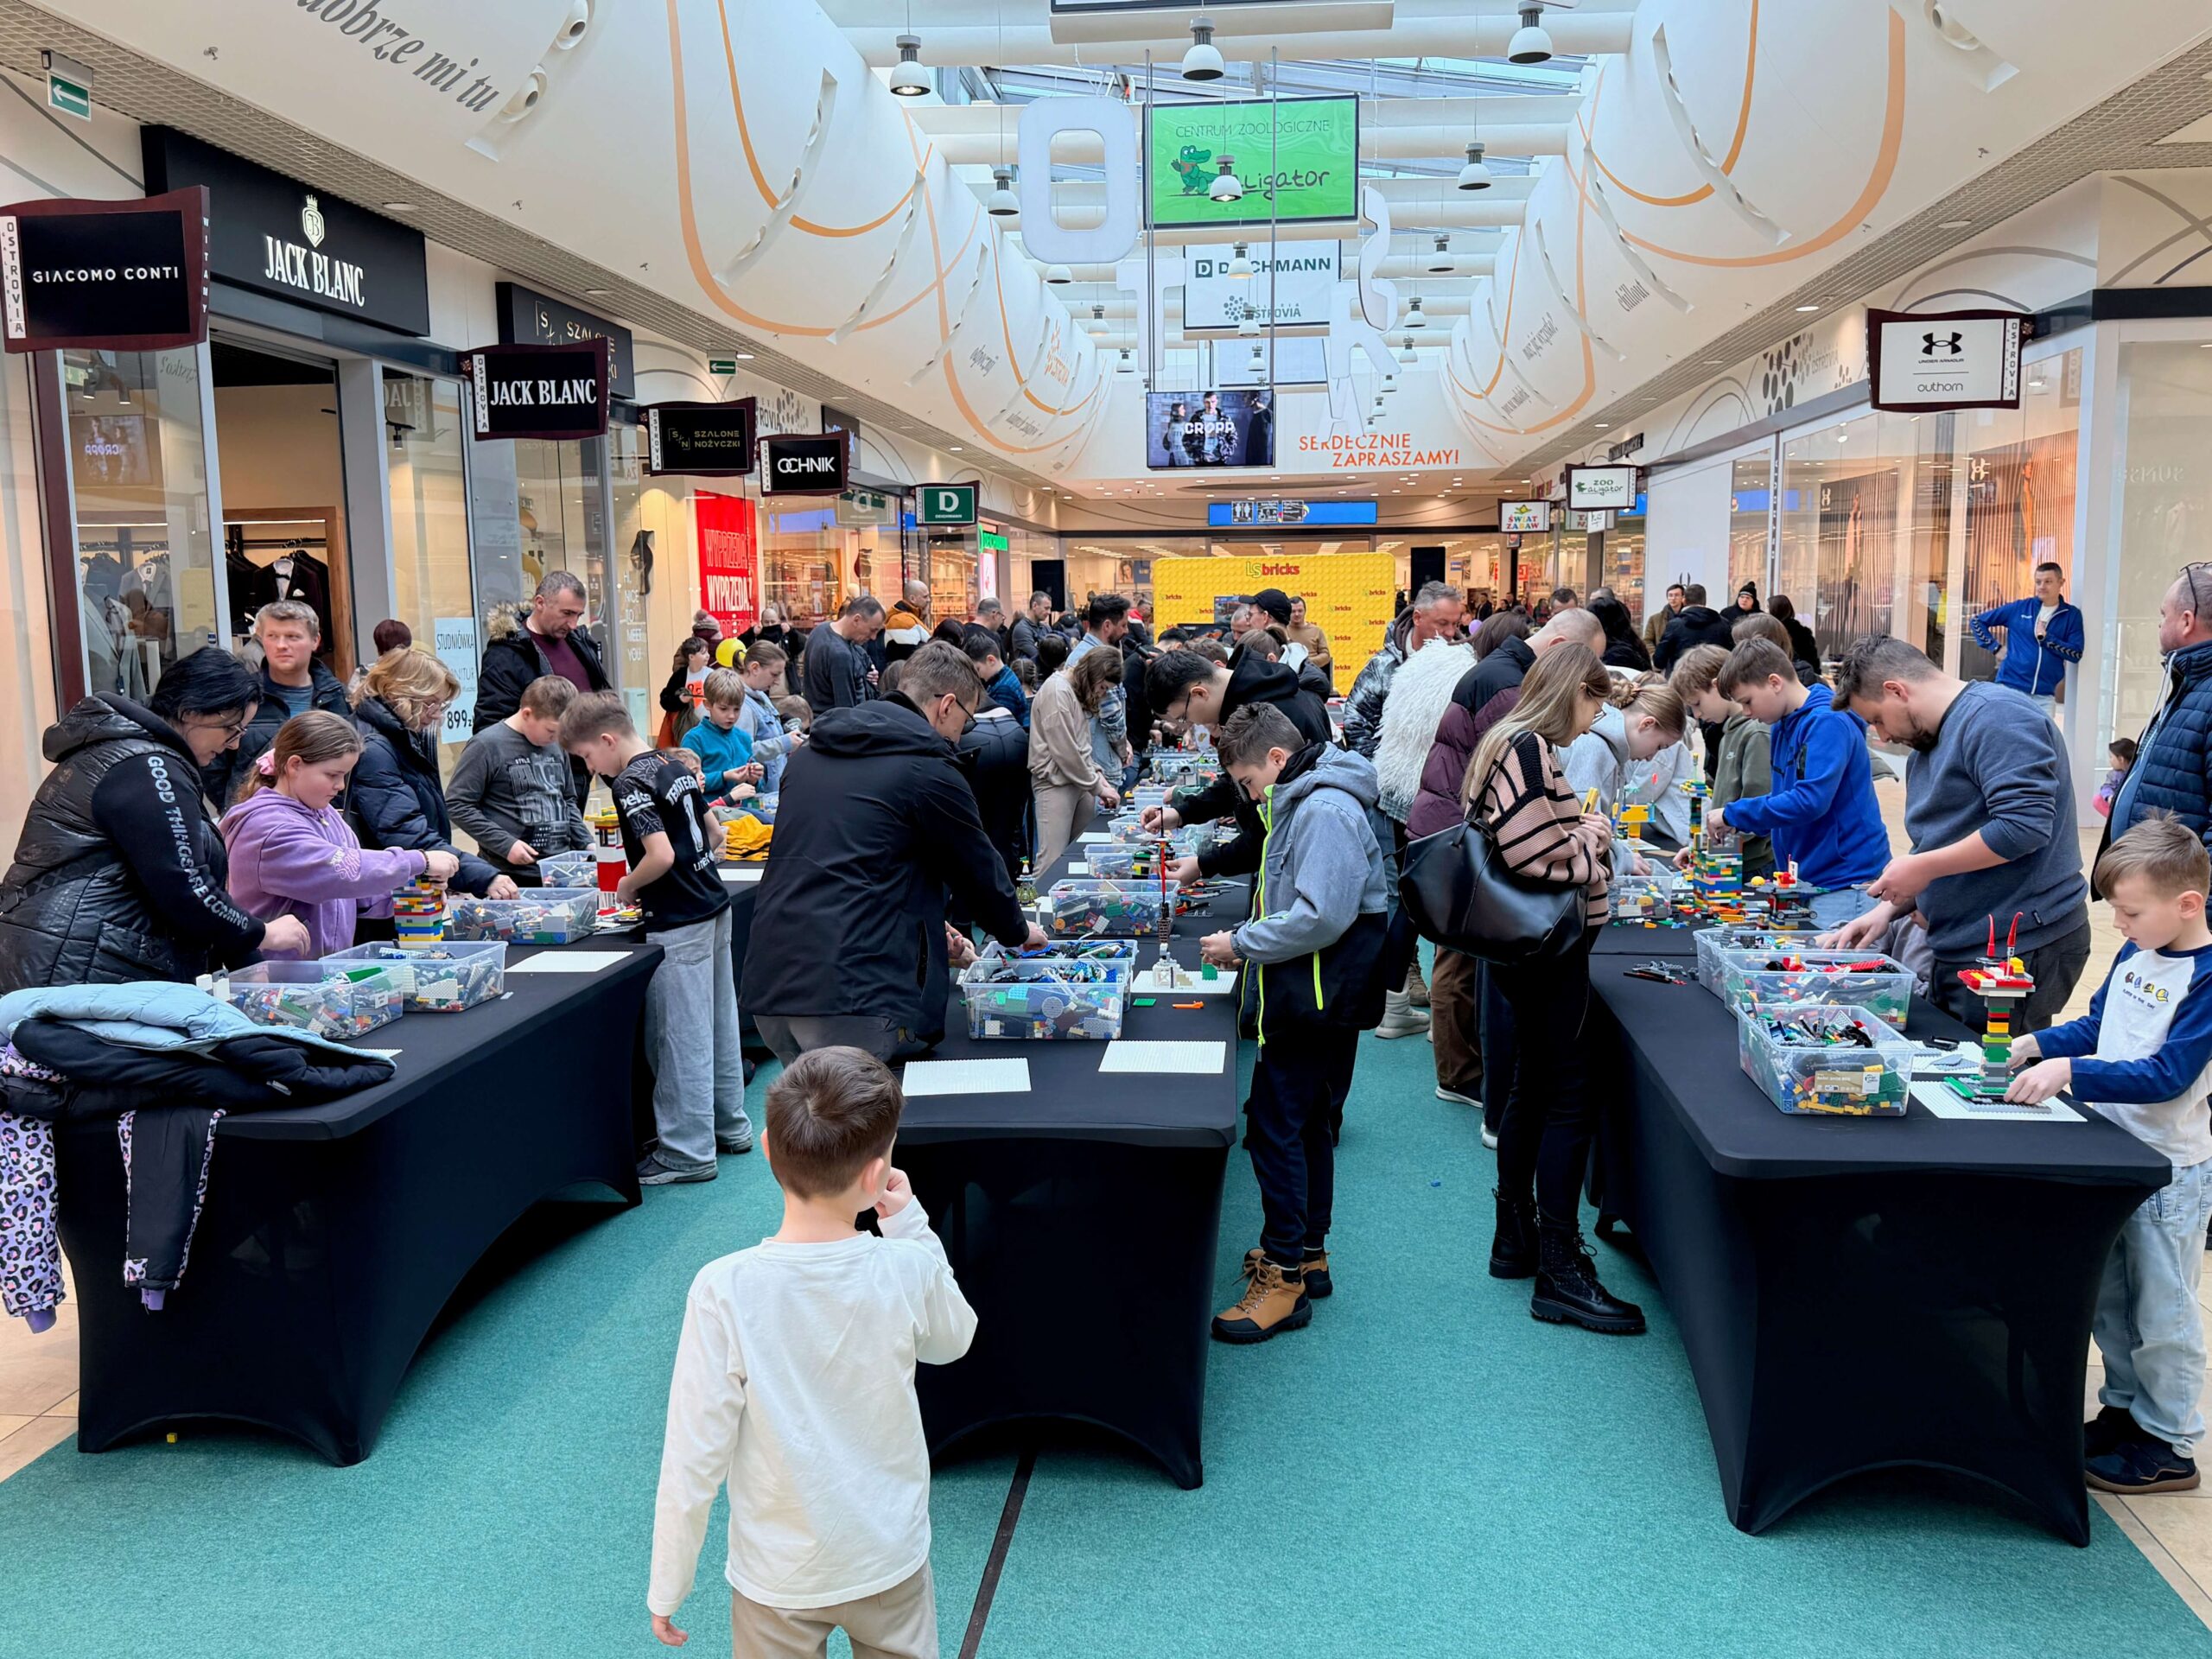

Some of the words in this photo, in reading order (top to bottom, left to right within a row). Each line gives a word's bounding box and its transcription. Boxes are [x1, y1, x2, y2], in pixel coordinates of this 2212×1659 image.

[412, 53, 479, 92] mi
[456, 75, 499, 112] tu
[1175, 124, 1232, 138] CENTRUM
[1238, 119, 1331, 136] ZOOLOGICZNE
[33, 269, 117, 283] GIACOMO
[124, 266, 179, 280] CONTI
[265, 235, 310, 290] JACK
[311, 251, 365, 308] BLANC
[1219, 257, 1331, 275] DCHMANN
[7, 221, 23, 334] OSTROVIA
[1615, 278, 1649, 312] chillout
[1255, 307, 1301, 319] STROVIA
[2009, 322, 2018, 397] OSTROVIA
[478, 358, 488, 429] OSTROVIA
[490, 380, 535, 405] JACK
[538, 378, 597, 404] BLANC
[1917, 382, 1963, 392] outhorn
[1185, 422, 1236, 434] CROPP
[652, 411, 661, 468] OSTROVIA
[695, 439, 741, 448] NOŻYCZKI
[778, 456, 836, 474] OCHNIK
[1332, 449, 1459, 467] ZAPRASZAMY!
[938, 491, 959, 512] D
[1508, 514, 1538, 523] ŚWIAT
[437, 629, 474, 650] STUDNIÓWKA
[447, 709, 467, 729] 899
[683, 793, 703, 853] 1
[148, 756, 176, 804] GOOD
[166, 806, 194, 869] THINGS
[184, 868, 210, 898] ARE
[203, 895, 249, 931] COMING
